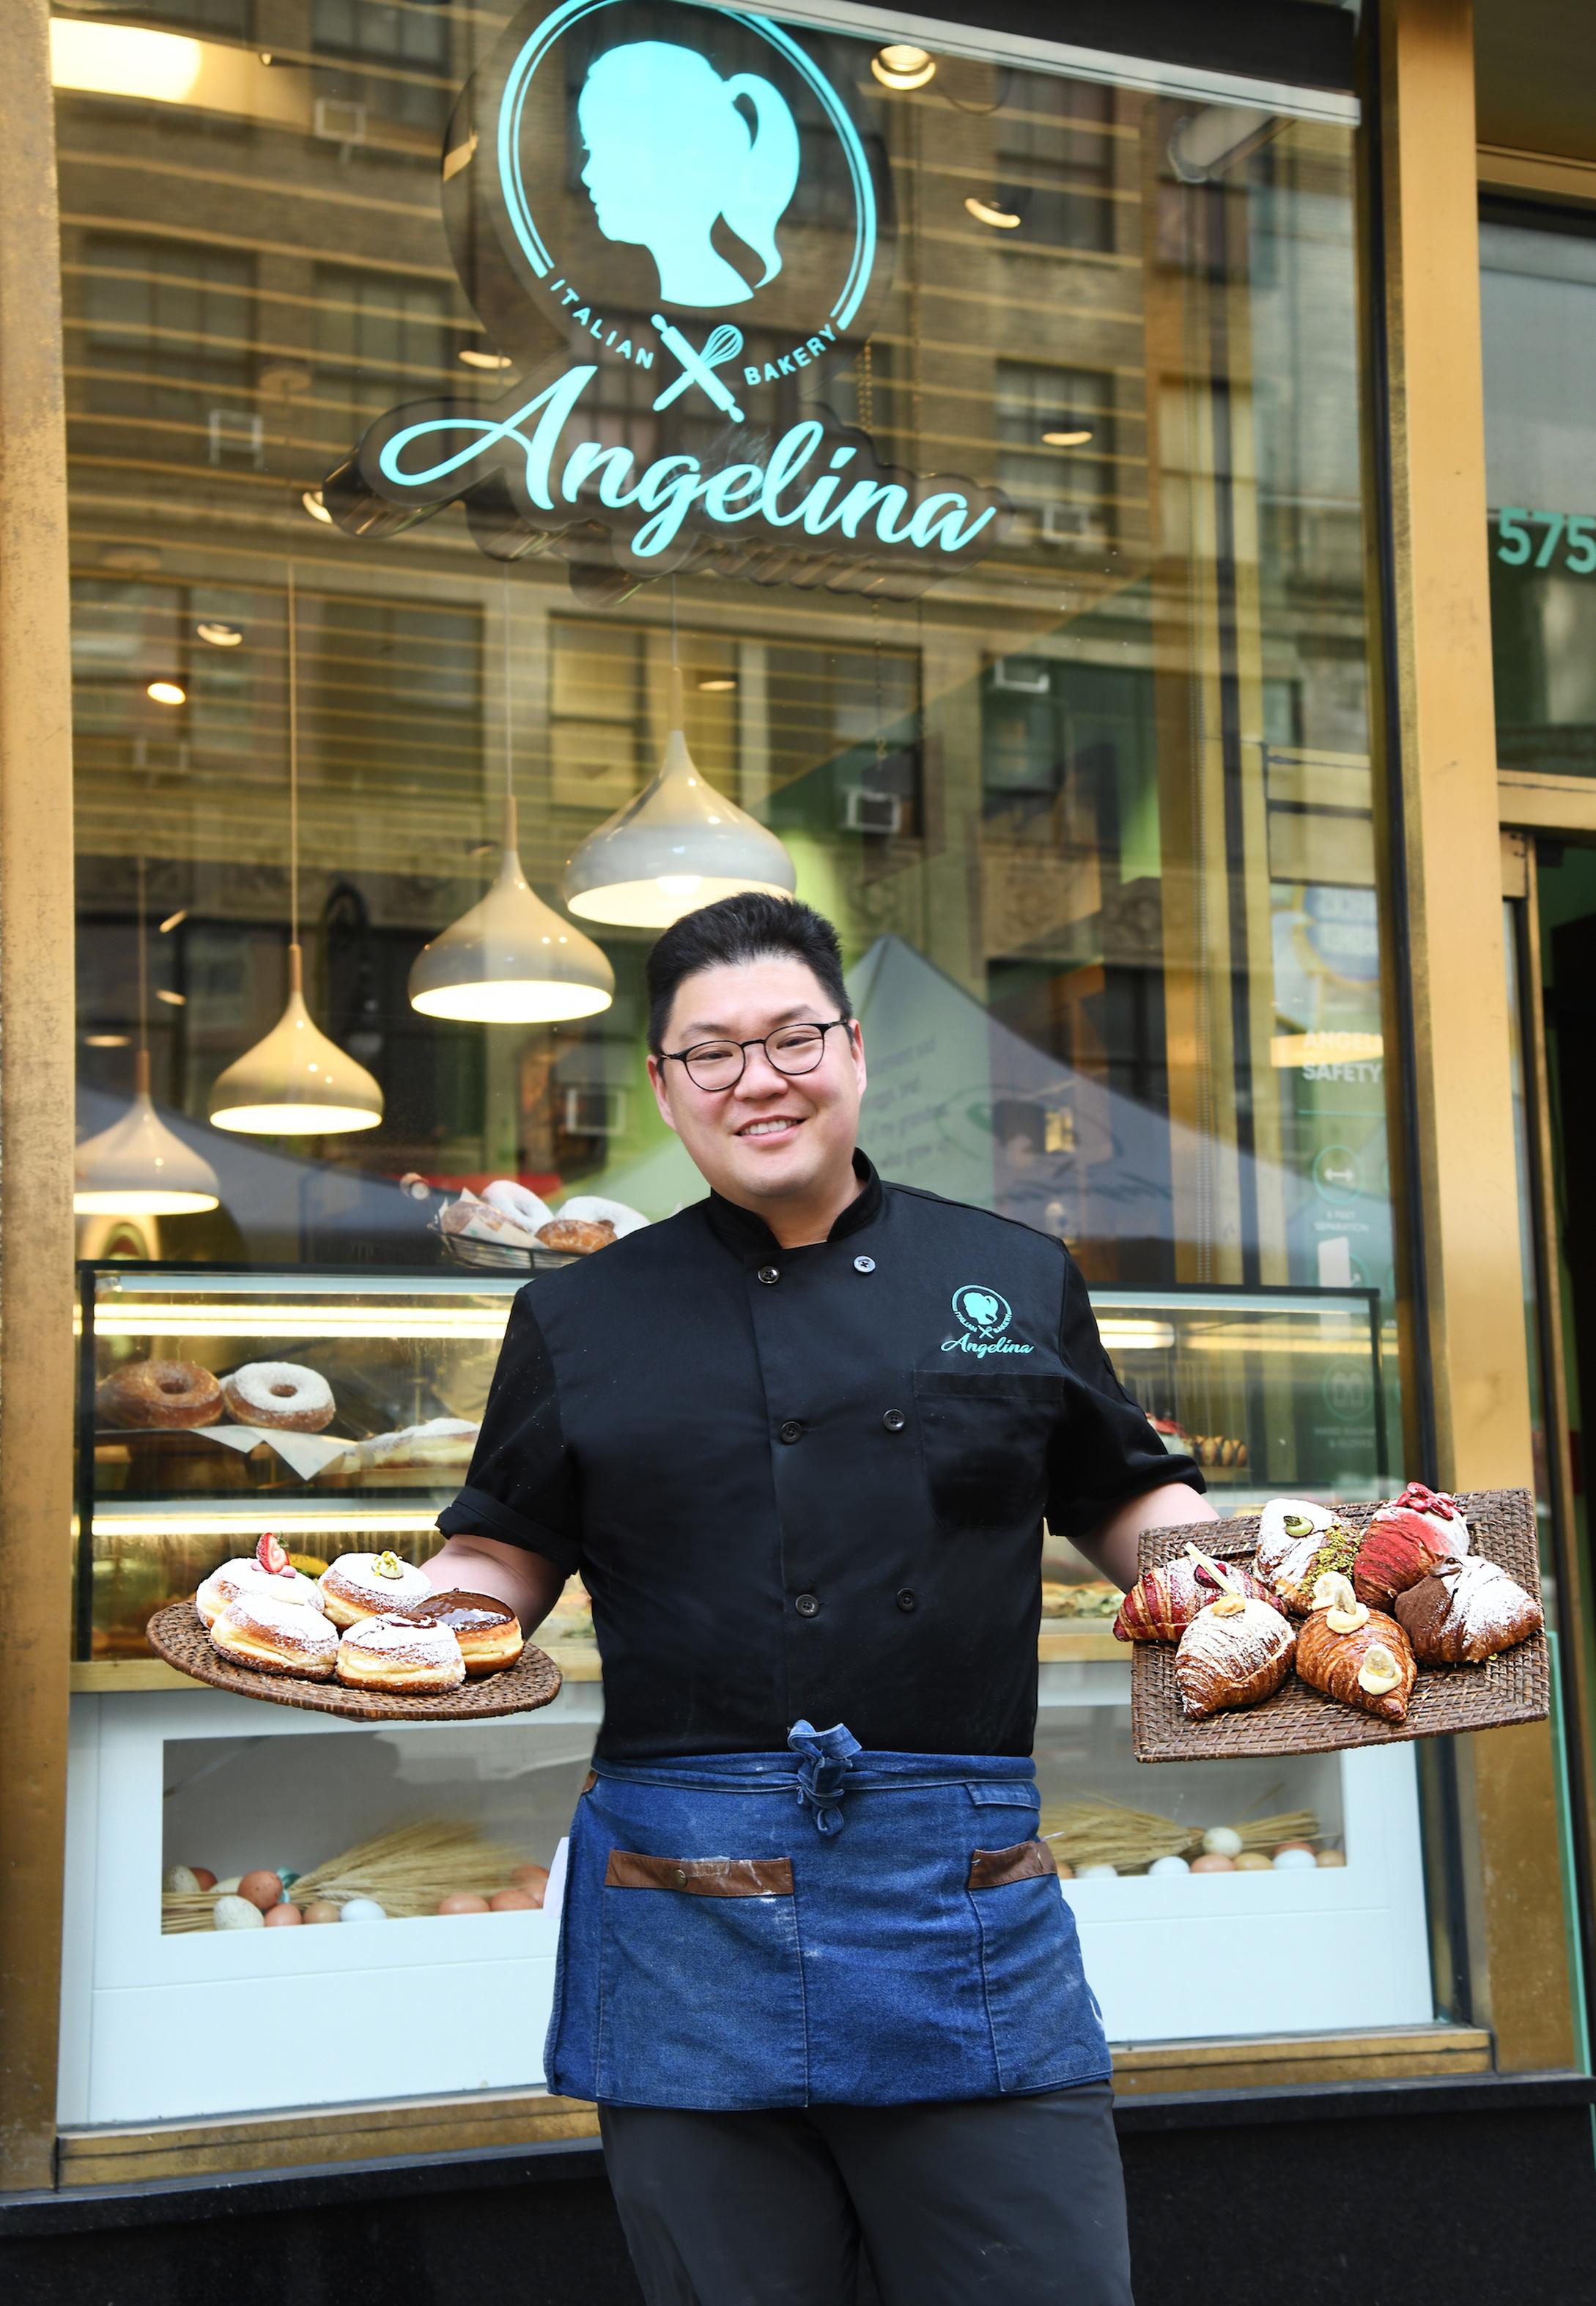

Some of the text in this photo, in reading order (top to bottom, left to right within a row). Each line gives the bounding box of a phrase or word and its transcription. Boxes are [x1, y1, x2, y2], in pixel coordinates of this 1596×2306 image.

[550, 279, 835, 385] ITALIAN BAKERY
[379, 365, 997, 558] Angelina
[1497, 506, 1596, 574] 575
[1302, 1063, 1382, 1083] SAFETY
[940, 1332, 1035, 1359] Angelina
[954, 1311, 978, 1333] ITALIAN
